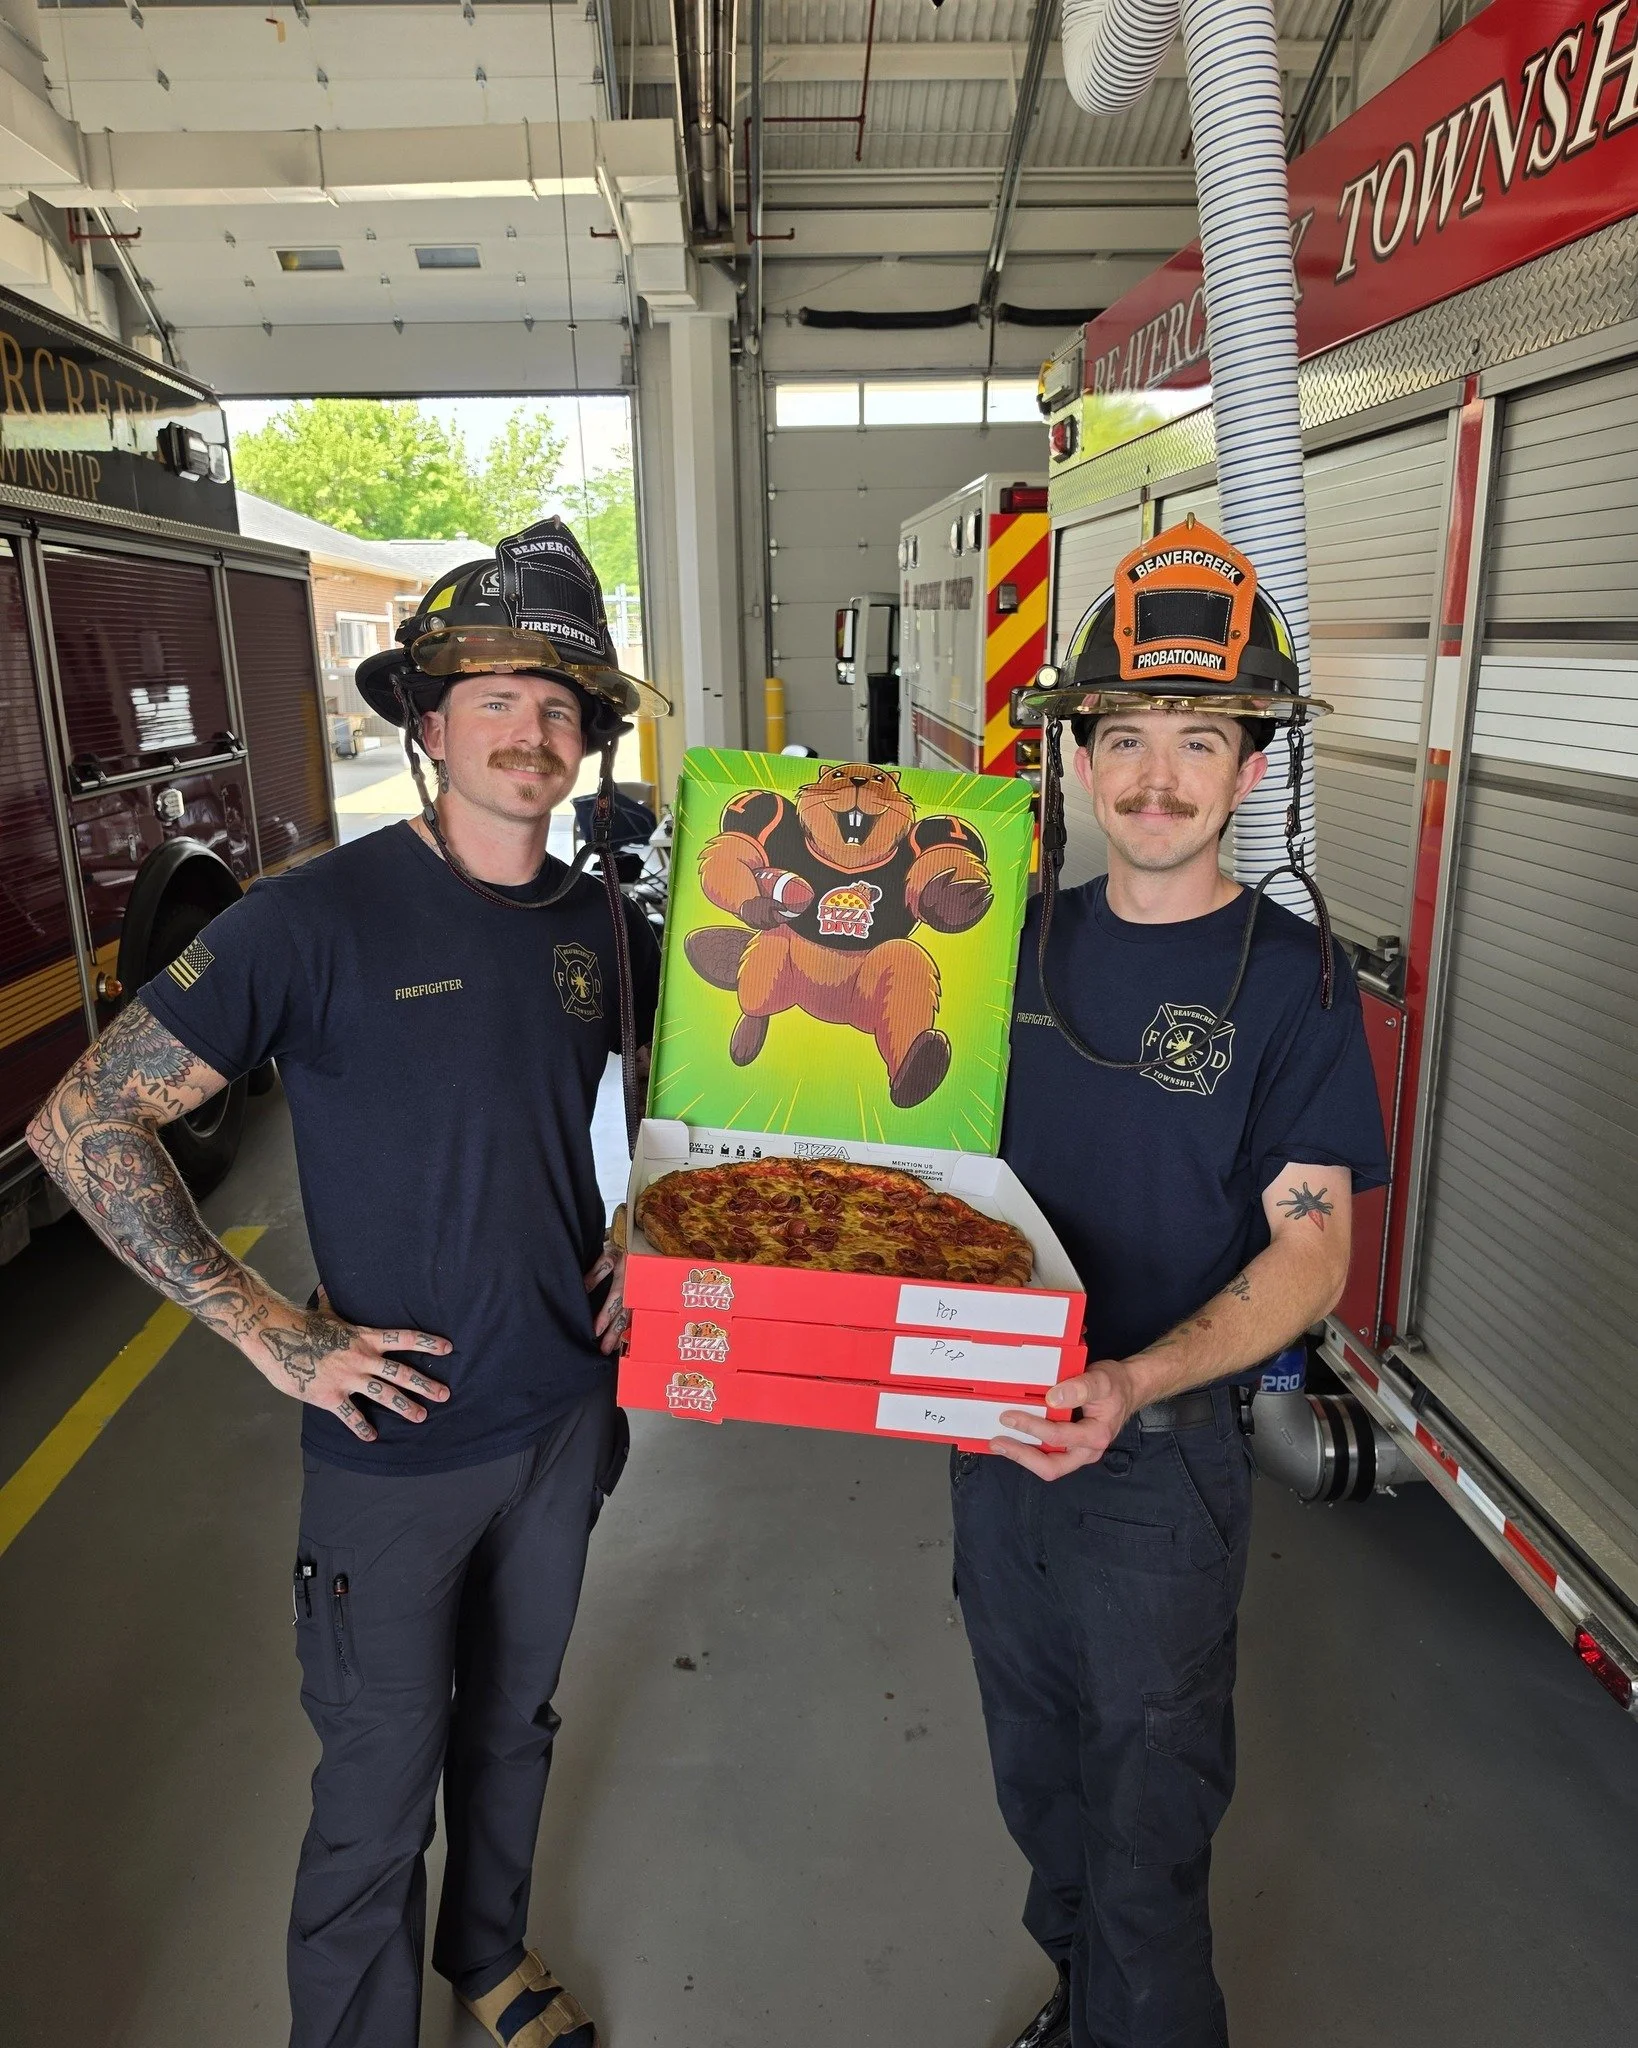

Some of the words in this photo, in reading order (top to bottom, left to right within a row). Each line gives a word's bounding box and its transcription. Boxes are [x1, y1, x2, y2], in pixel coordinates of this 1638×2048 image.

[1092, 206, 1316, 398] BEAVERCK
[1135, 550, 1241, 583] BEAVERCREEK
[520, 621, 597, 648] FIREFIGHTER
[1137, 649, 1223, 669] PROBATIONARY
[819, 906, 873, 924] PIZZA
[821, 920, 868, 937] DIVE
[394, 978, 464, 1001] FIREFIGHTER
[1145, 1029, 1161, 1047] F
[1210, 1051, 1226, 1069] D
[1153, 1070, 1195, 1088] TOWNSHIP
[794, 1142, 850, 1160] PIZZA
[891, 1160, 923, 1168] MENTION
[683, 1282, 734, 1298] PIZZA
[685, 1295, 730, 1310] DIVE
[679, 1336, 730, 1352] PIZZA
[681, 1348, 725, 1362] DIVE
[1261, 1373, 1300, 1391] PRO
[667, 1386, 717, 1401] PIZZA
[669, 1397, 713, 1411] DIVE
